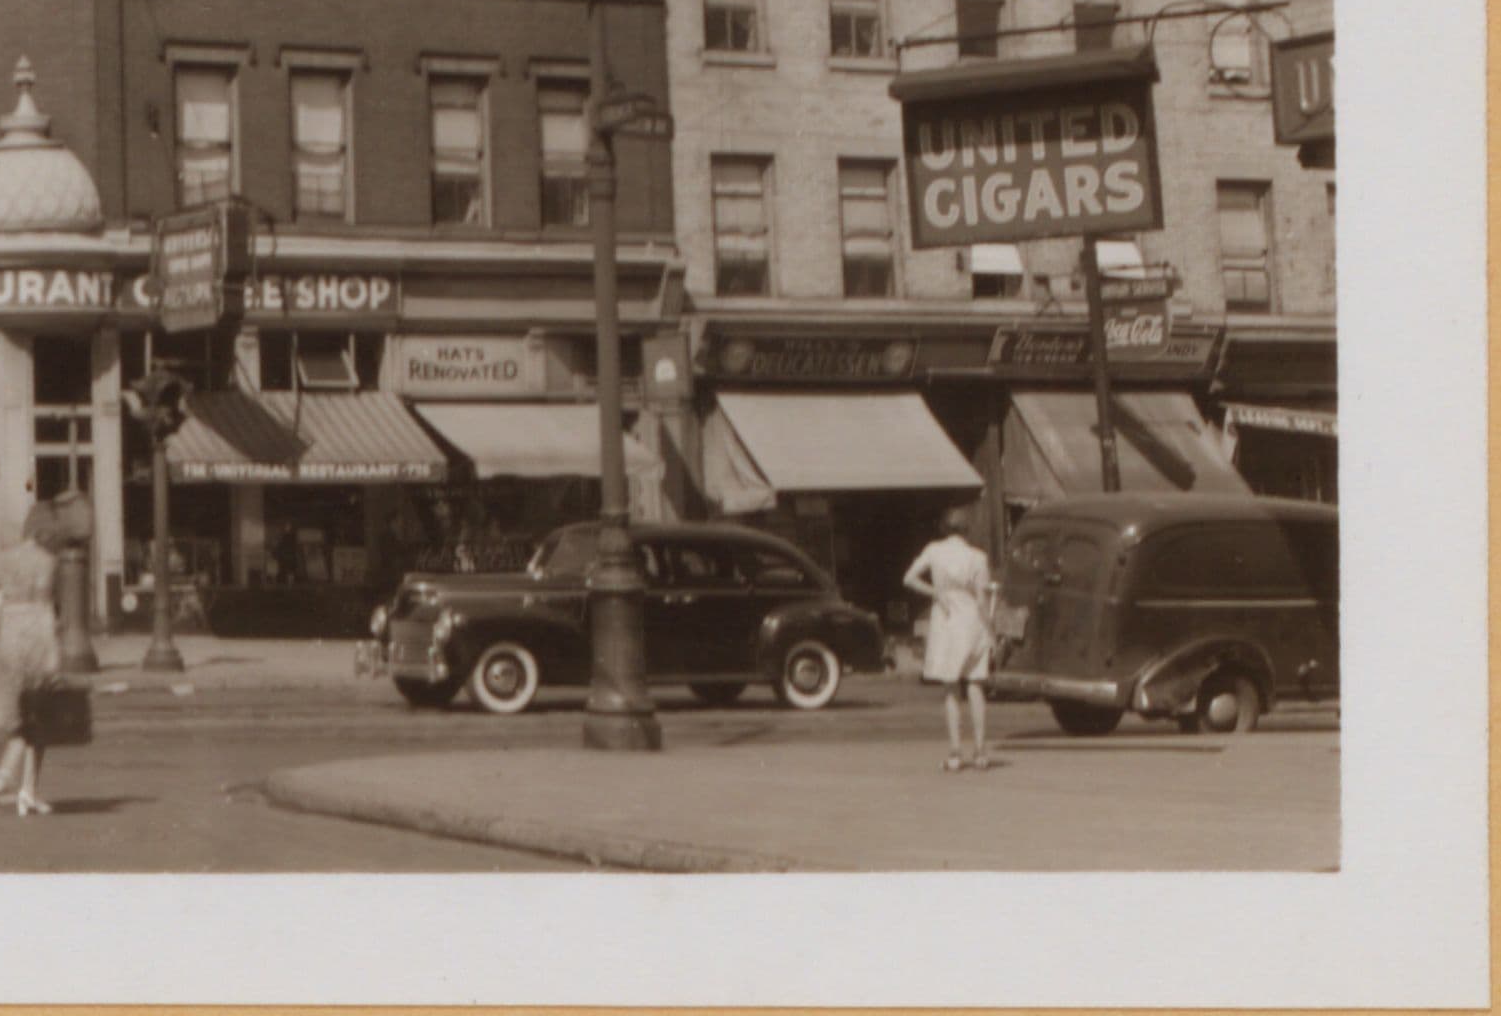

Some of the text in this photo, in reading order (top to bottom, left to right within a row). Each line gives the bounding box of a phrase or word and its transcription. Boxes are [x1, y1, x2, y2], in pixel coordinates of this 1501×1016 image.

[918, 102, 1140, 172] UNITED
[923, 159, 1146, 229] CIGARS
[296, 275, 391, 310] SHOP
[438, 346, 485, 361] HATS
[409, 359, 518, 381] RENOVATED
[299, 464, 400, 480] RESTAURANT
